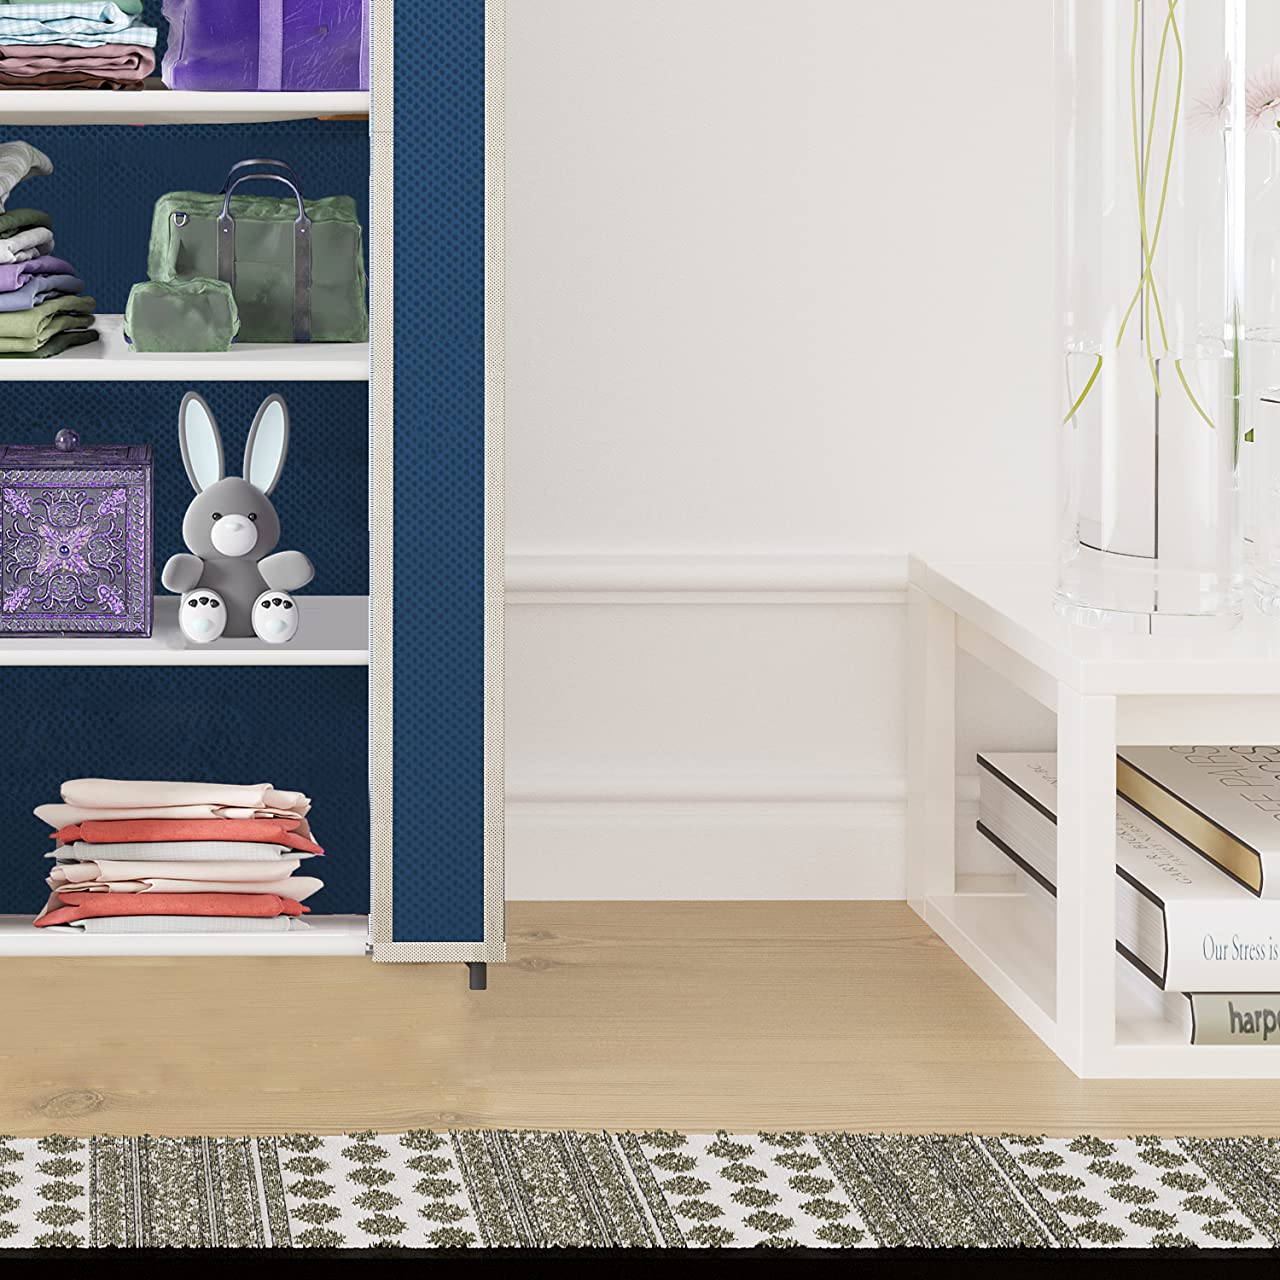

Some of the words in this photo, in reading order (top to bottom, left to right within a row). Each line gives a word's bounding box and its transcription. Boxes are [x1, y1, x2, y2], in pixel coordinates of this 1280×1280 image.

[1169, 746, 1274, 787] PAIRS
[1203, 934, 1228, 961] Our
[1232, 934, 1265, 961] Stress
[1269, 936, 1278, 961] is
[1228, 1001, 1280, 1041] harp
